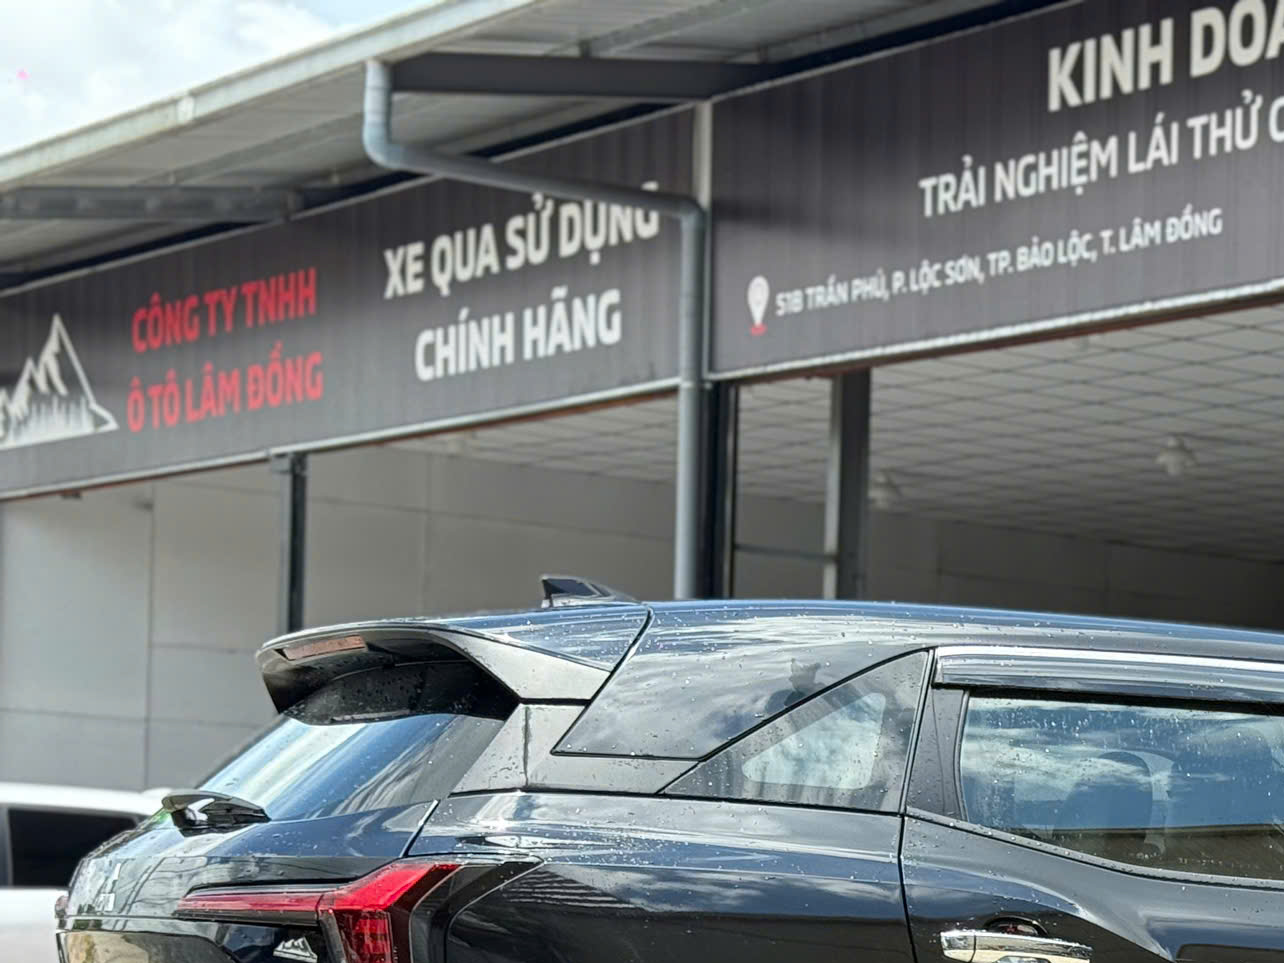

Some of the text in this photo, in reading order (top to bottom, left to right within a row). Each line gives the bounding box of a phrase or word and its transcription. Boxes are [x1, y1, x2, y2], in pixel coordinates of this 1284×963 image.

[1048, 19, 1172, 111] KINH
[919, 155, 986, 217] TRẢI
[994, 131, 1118, 203] NGHIỆM
[1128, 112, 1179, 174] LÁI
[1187, 89, 1263, 160] THỬ
[384, 241, 425, 300] XE
[430, 223, 500, 297] QUA
[505, 191, 555, 271] SỬ
[987, 250, 1014, 277] TP.
[1100, 230, 1117, 255] T.
[1118, 217, 1162, 252] LÂM
[132, 267, 317, 353] CÔNG TY TNHH
[415, 285, 622, 382] CHÍNH HÃNG
[127, 376, 145, 432] Ô
[184, 361, 241, 424] LÂM
